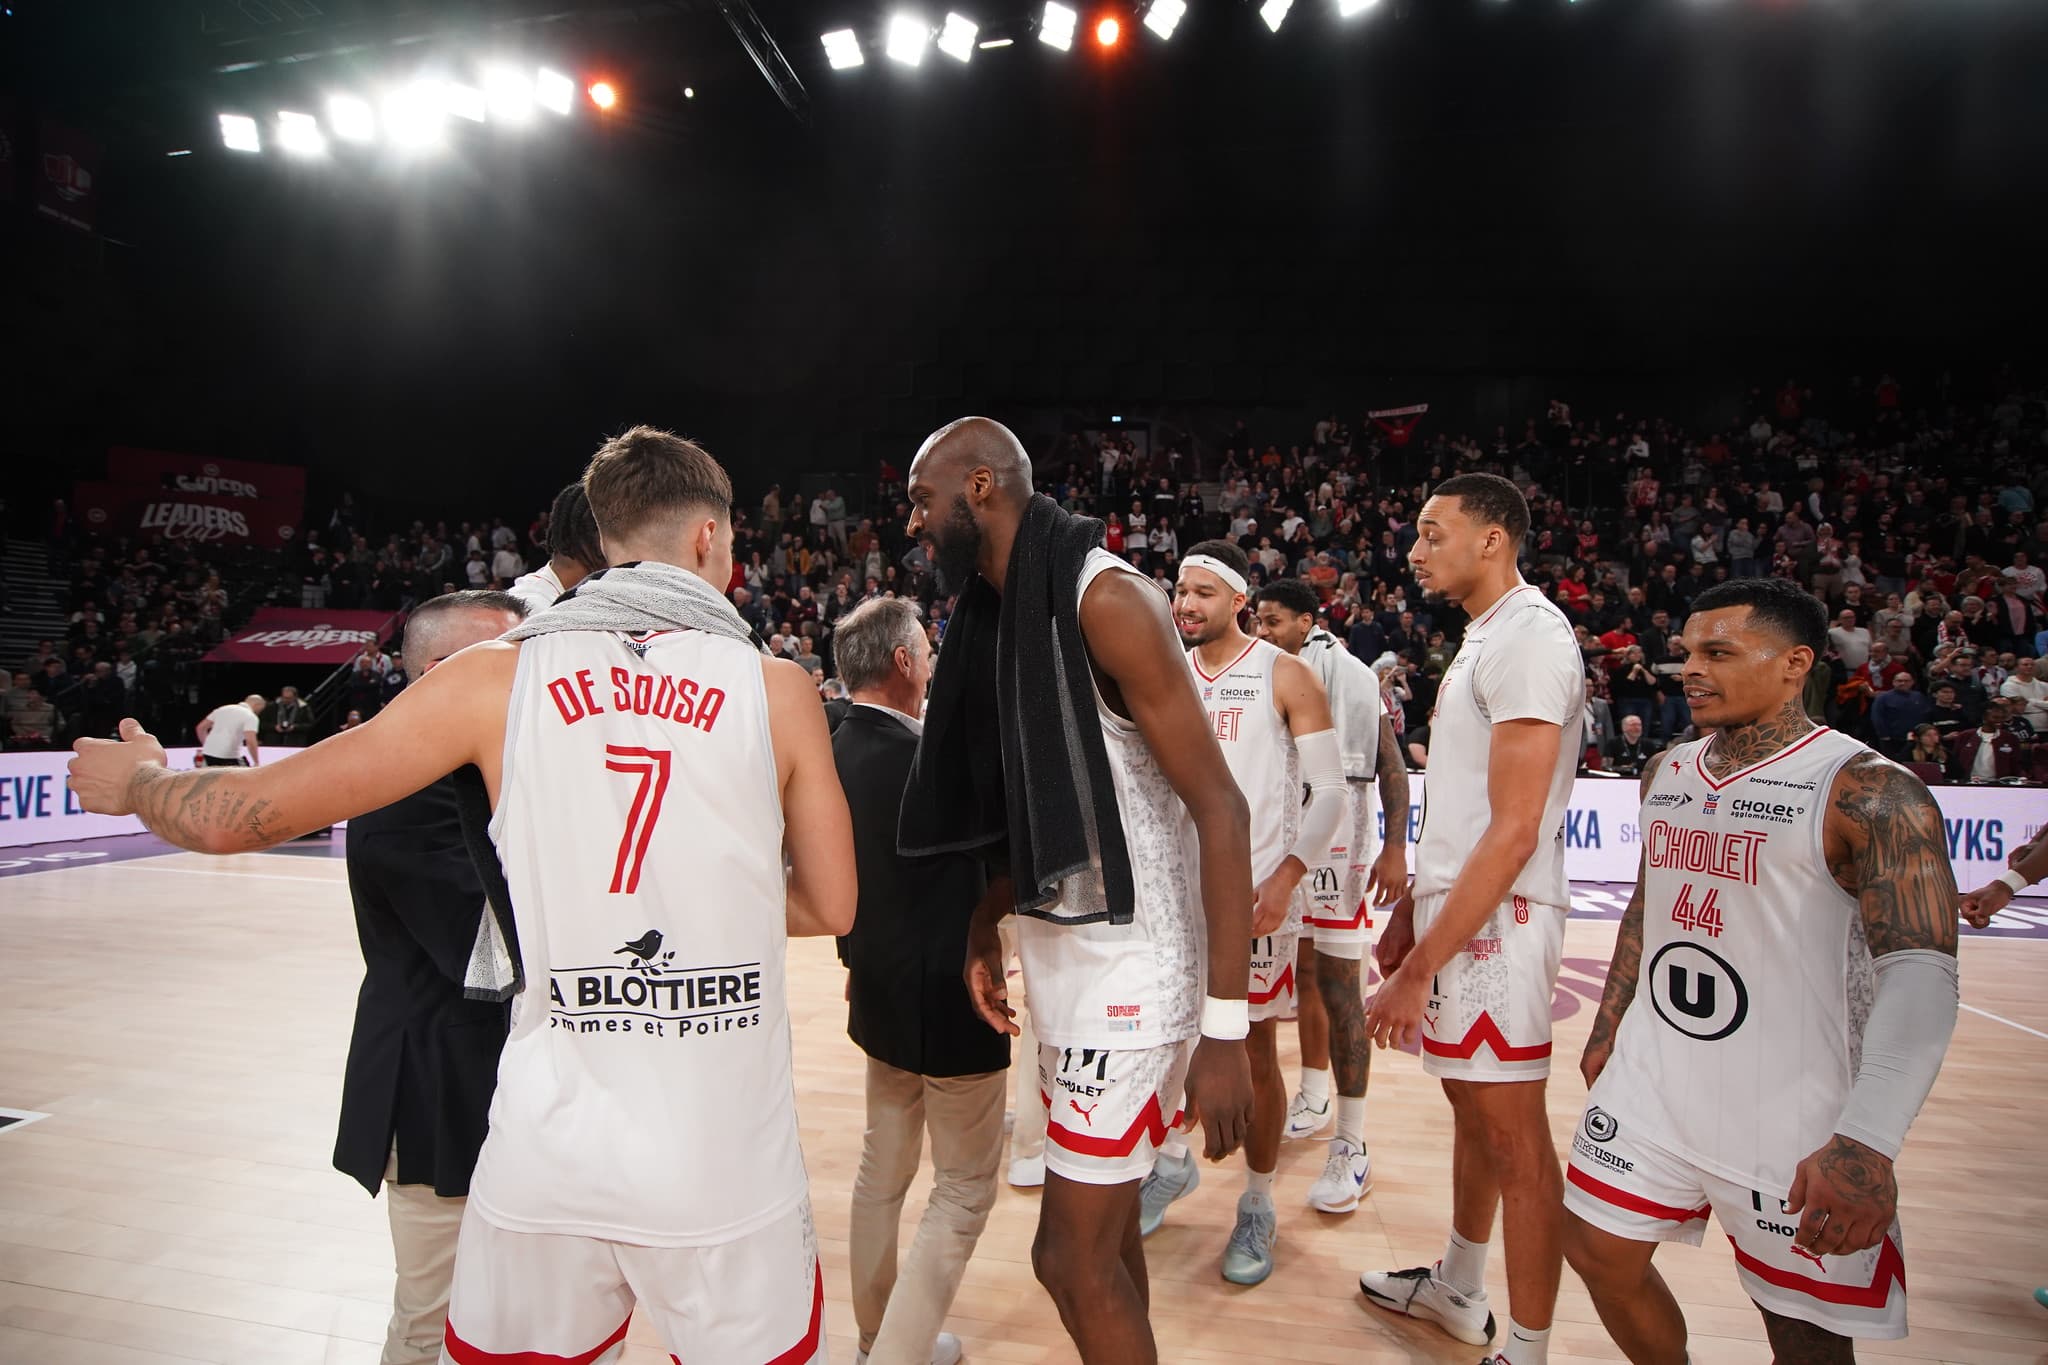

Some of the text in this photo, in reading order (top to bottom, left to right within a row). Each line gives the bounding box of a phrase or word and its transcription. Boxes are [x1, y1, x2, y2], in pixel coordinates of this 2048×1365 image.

[140, 503, 249, 537] LEADERS
[236, 629, 377, 646] LEADERS
[548, 667, 726, 733] DE SOUSA
[1749, 776, 1784, 786] bouyer
[605, 743, 671, 894] 7
[1566, 809, 1601, 849] KA
[1730, 810, 1793, 825] agglomération
[1650, 820, 1768, 885] CHOLET
[1514, 895, 1529, 925] 8
[1671, 883, 1724, 938] 44
[578, 971, 761, 1011] BLOTTIERE
[1669, 964, 1716, 1019] U
[644, 1021, 663, 1038] et
[679, 1013, 760, 1038] Poires
[1056, 1077, 1106, 1097] CHOLET
[1756, 1218, 1799, 1237] CHO
